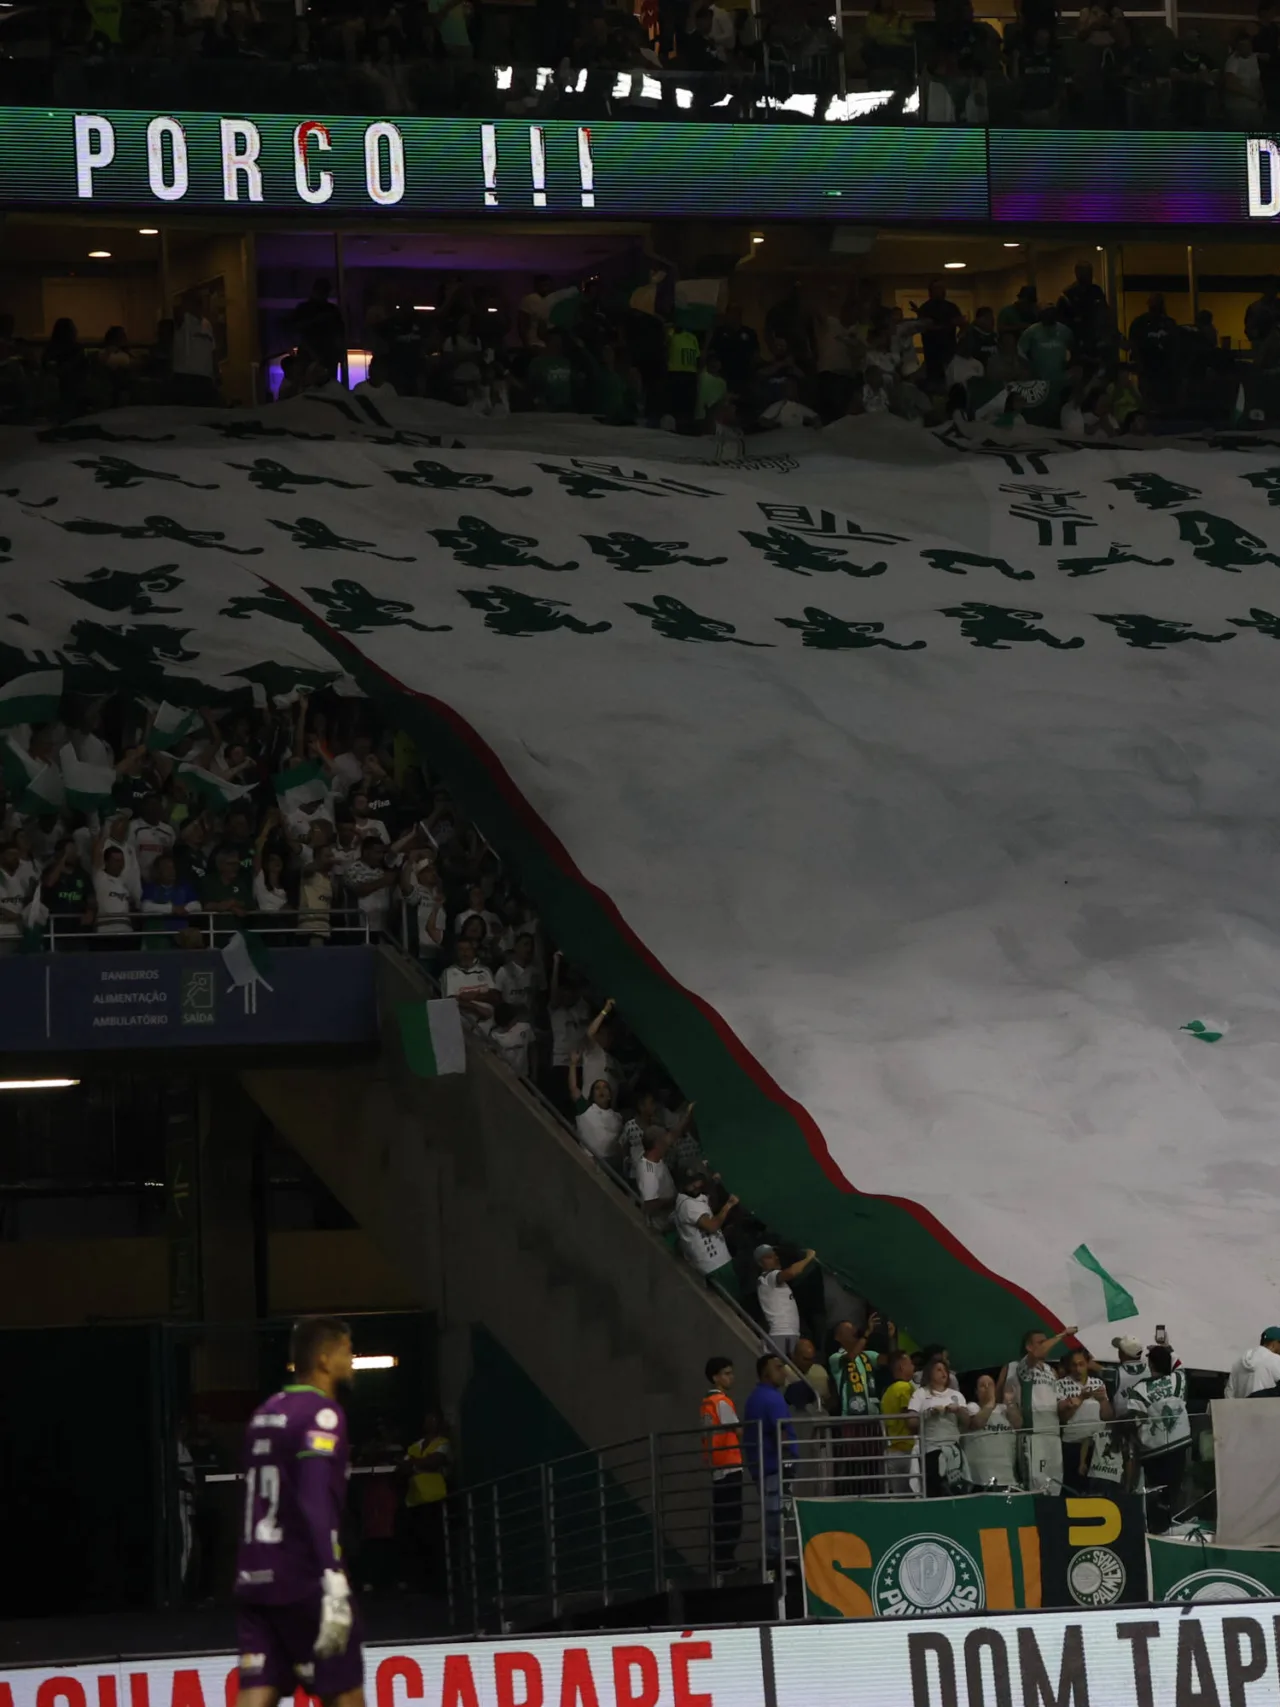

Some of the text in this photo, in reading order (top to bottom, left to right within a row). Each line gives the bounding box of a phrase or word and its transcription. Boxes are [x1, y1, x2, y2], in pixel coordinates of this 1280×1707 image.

[75, 115, 596, 208] PORCO !!!
[101, 969, 160, 981] BANHEIROS
[92, 989, 168, 1005] ALIMENTAÇÃO
[92, 1014, 169, 1027] AMBULATÓRIO
[183, 1011, 215, 1025] SAÍDA
[243, 1463, 284, 1545] 12
[1092, 1550, 1122, 1607] PALMEIRAS
[908, 1624, 1090, 1707] DOM
